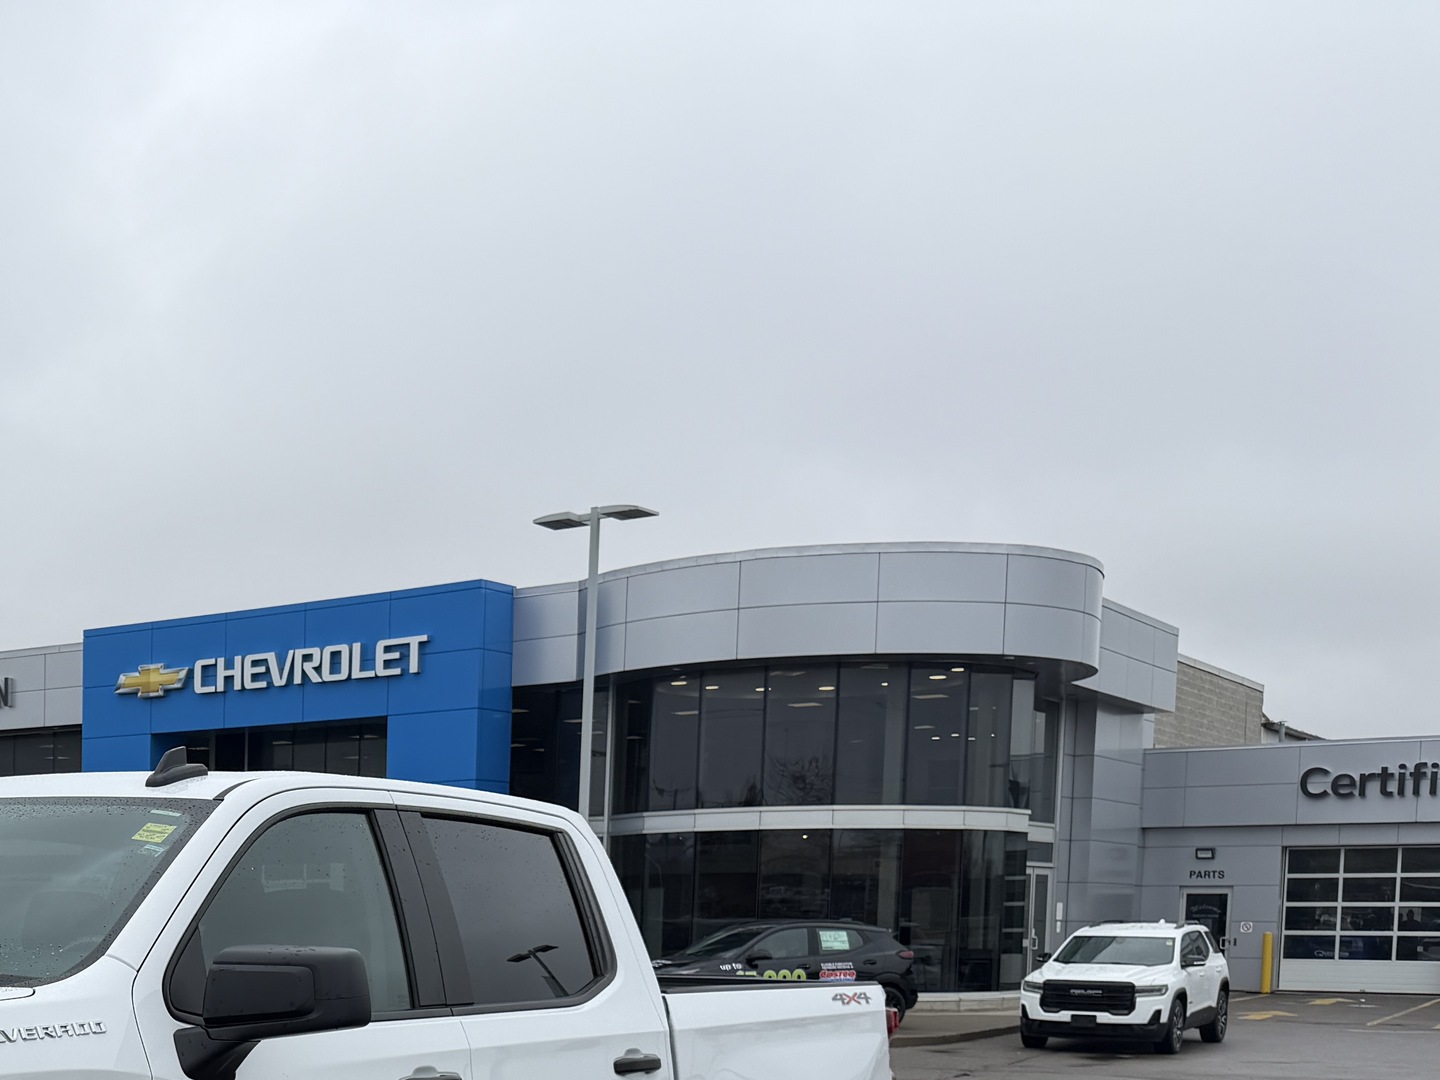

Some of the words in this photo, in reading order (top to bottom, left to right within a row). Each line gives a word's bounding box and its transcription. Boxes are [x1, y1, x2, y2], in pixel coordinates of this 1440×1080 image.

[193, 634, 429, 694] CHEVROLET
[1300, 761, 1440, 800] Certifi
[1189, 870, 1225, 879] PARTS
[720, 964, 731, 972] up
[732, 962, 743, 970] to
